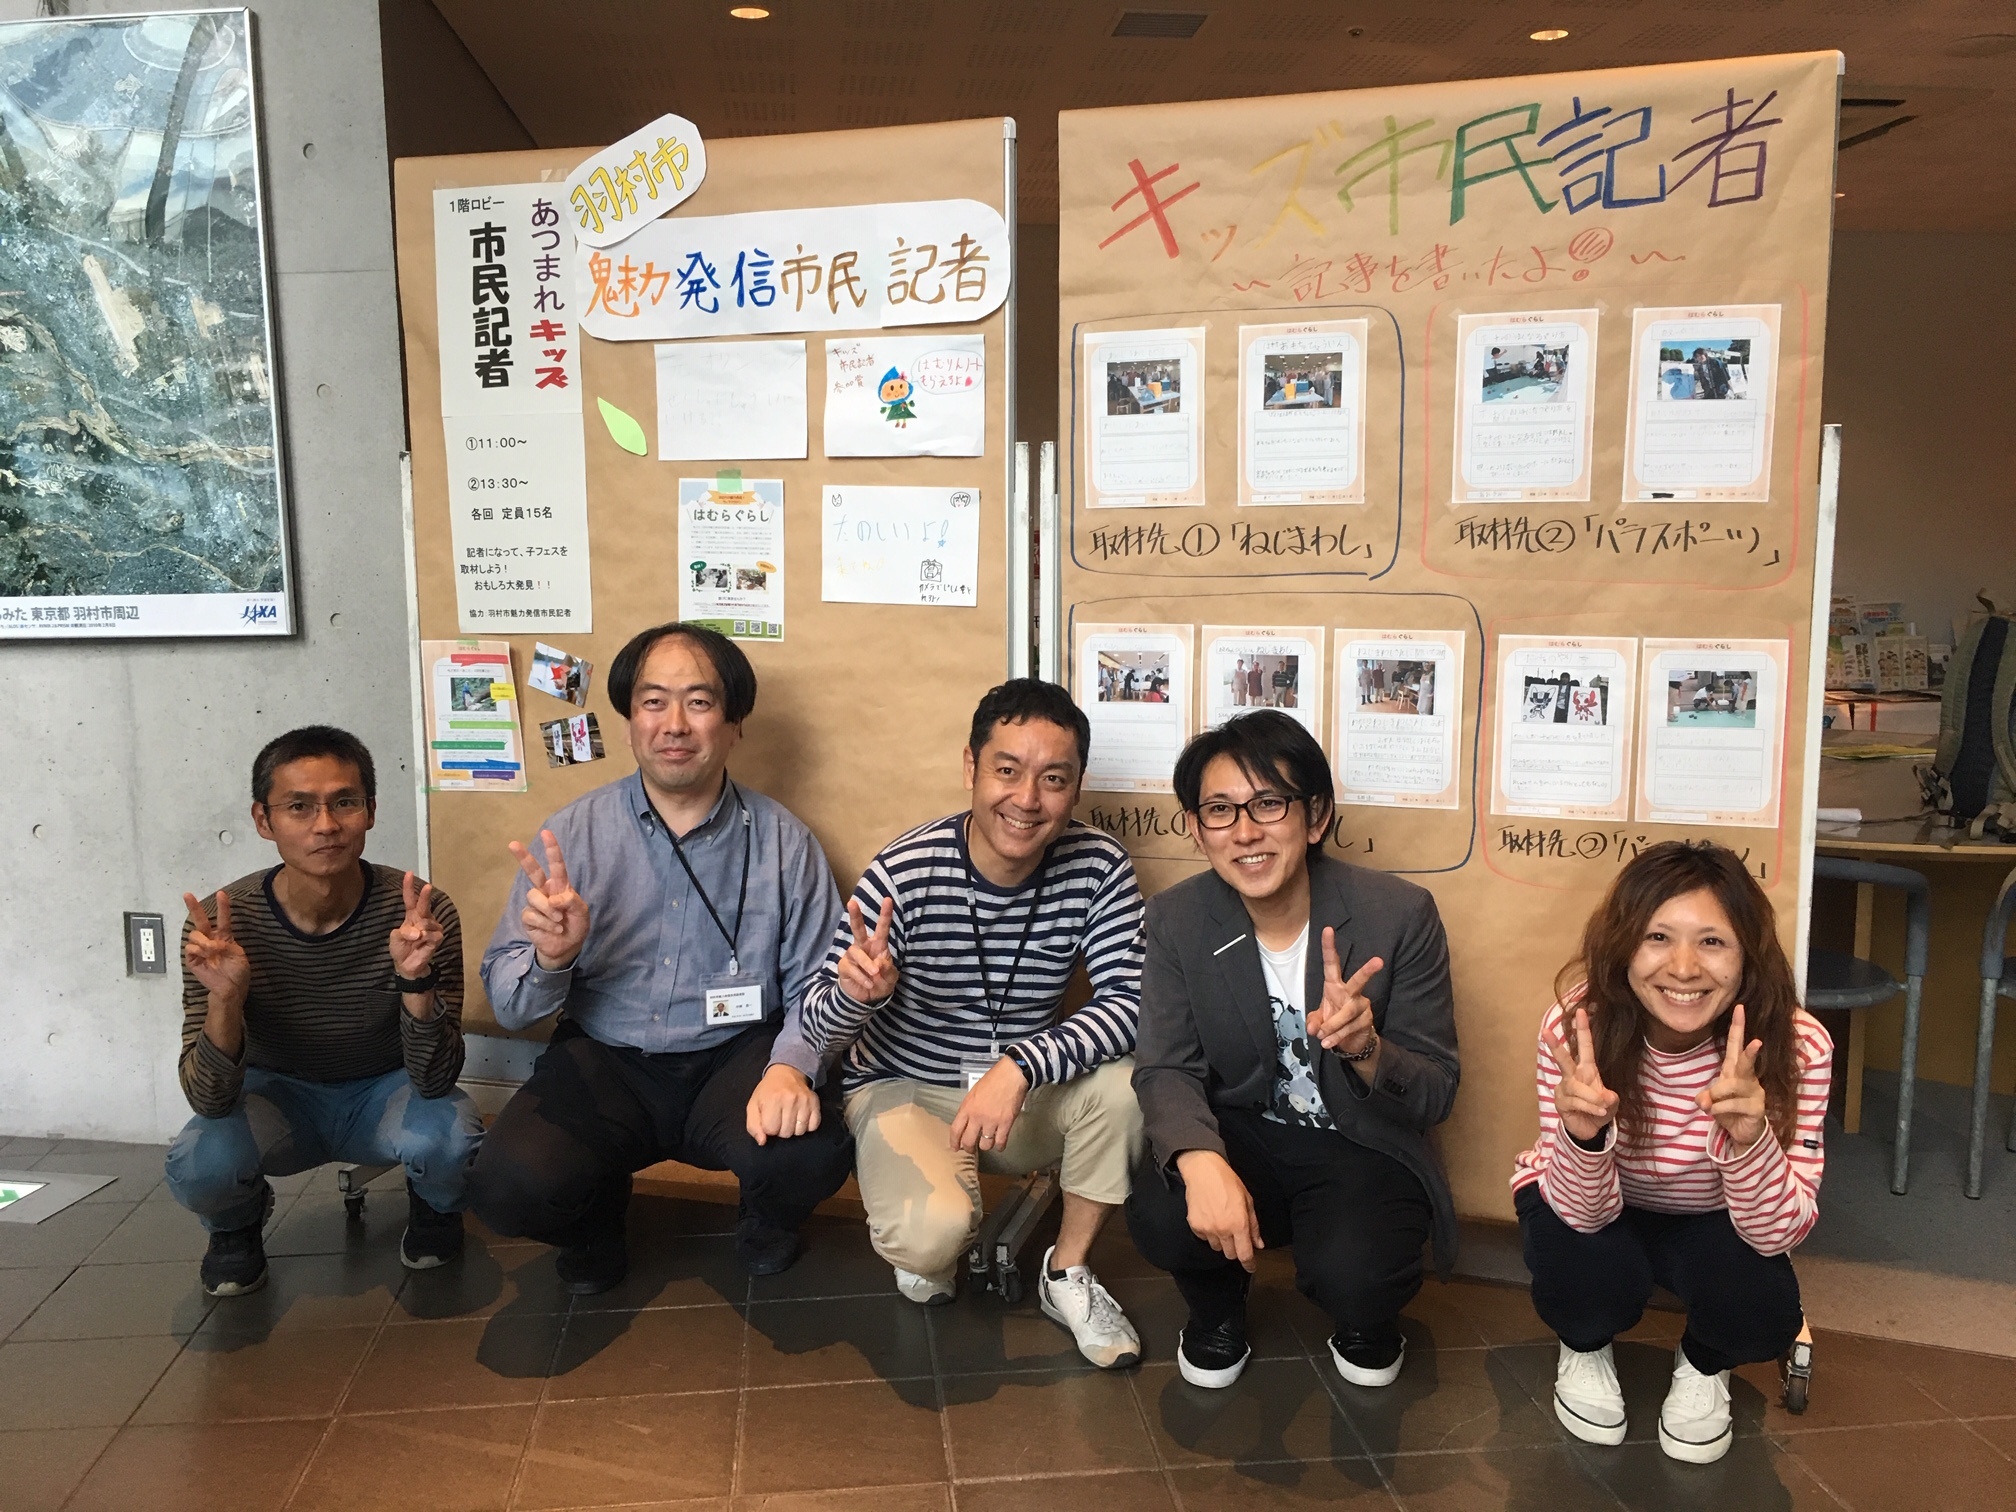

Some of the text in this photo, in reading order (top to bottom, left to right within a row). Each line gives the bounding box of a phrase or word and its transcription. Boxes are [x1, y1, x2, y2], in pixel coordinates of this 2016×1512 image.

[1098, 87, 1784, 260] キッズ市民記者
[569, 135, 689, 234] 羽村市
[449, 195, 505, 213] 1階ロビー
[583, 232, 991, 318] 魅力発信市民記者
[468, 221, 514, 389] 市民記者
[838, 354, 875, 372] 市民記者
[471, 506, 553, 521] 各回 定員15名
[693, 508, 770, 523] はむらぐらし
[466, 546, 569, 559] 記者になって、子フェスを
[31, 606, 70, 622] 東京都
[72, 605, 140, 621] 羽村市周辺
[238, 603, 278, 626] JAXA
